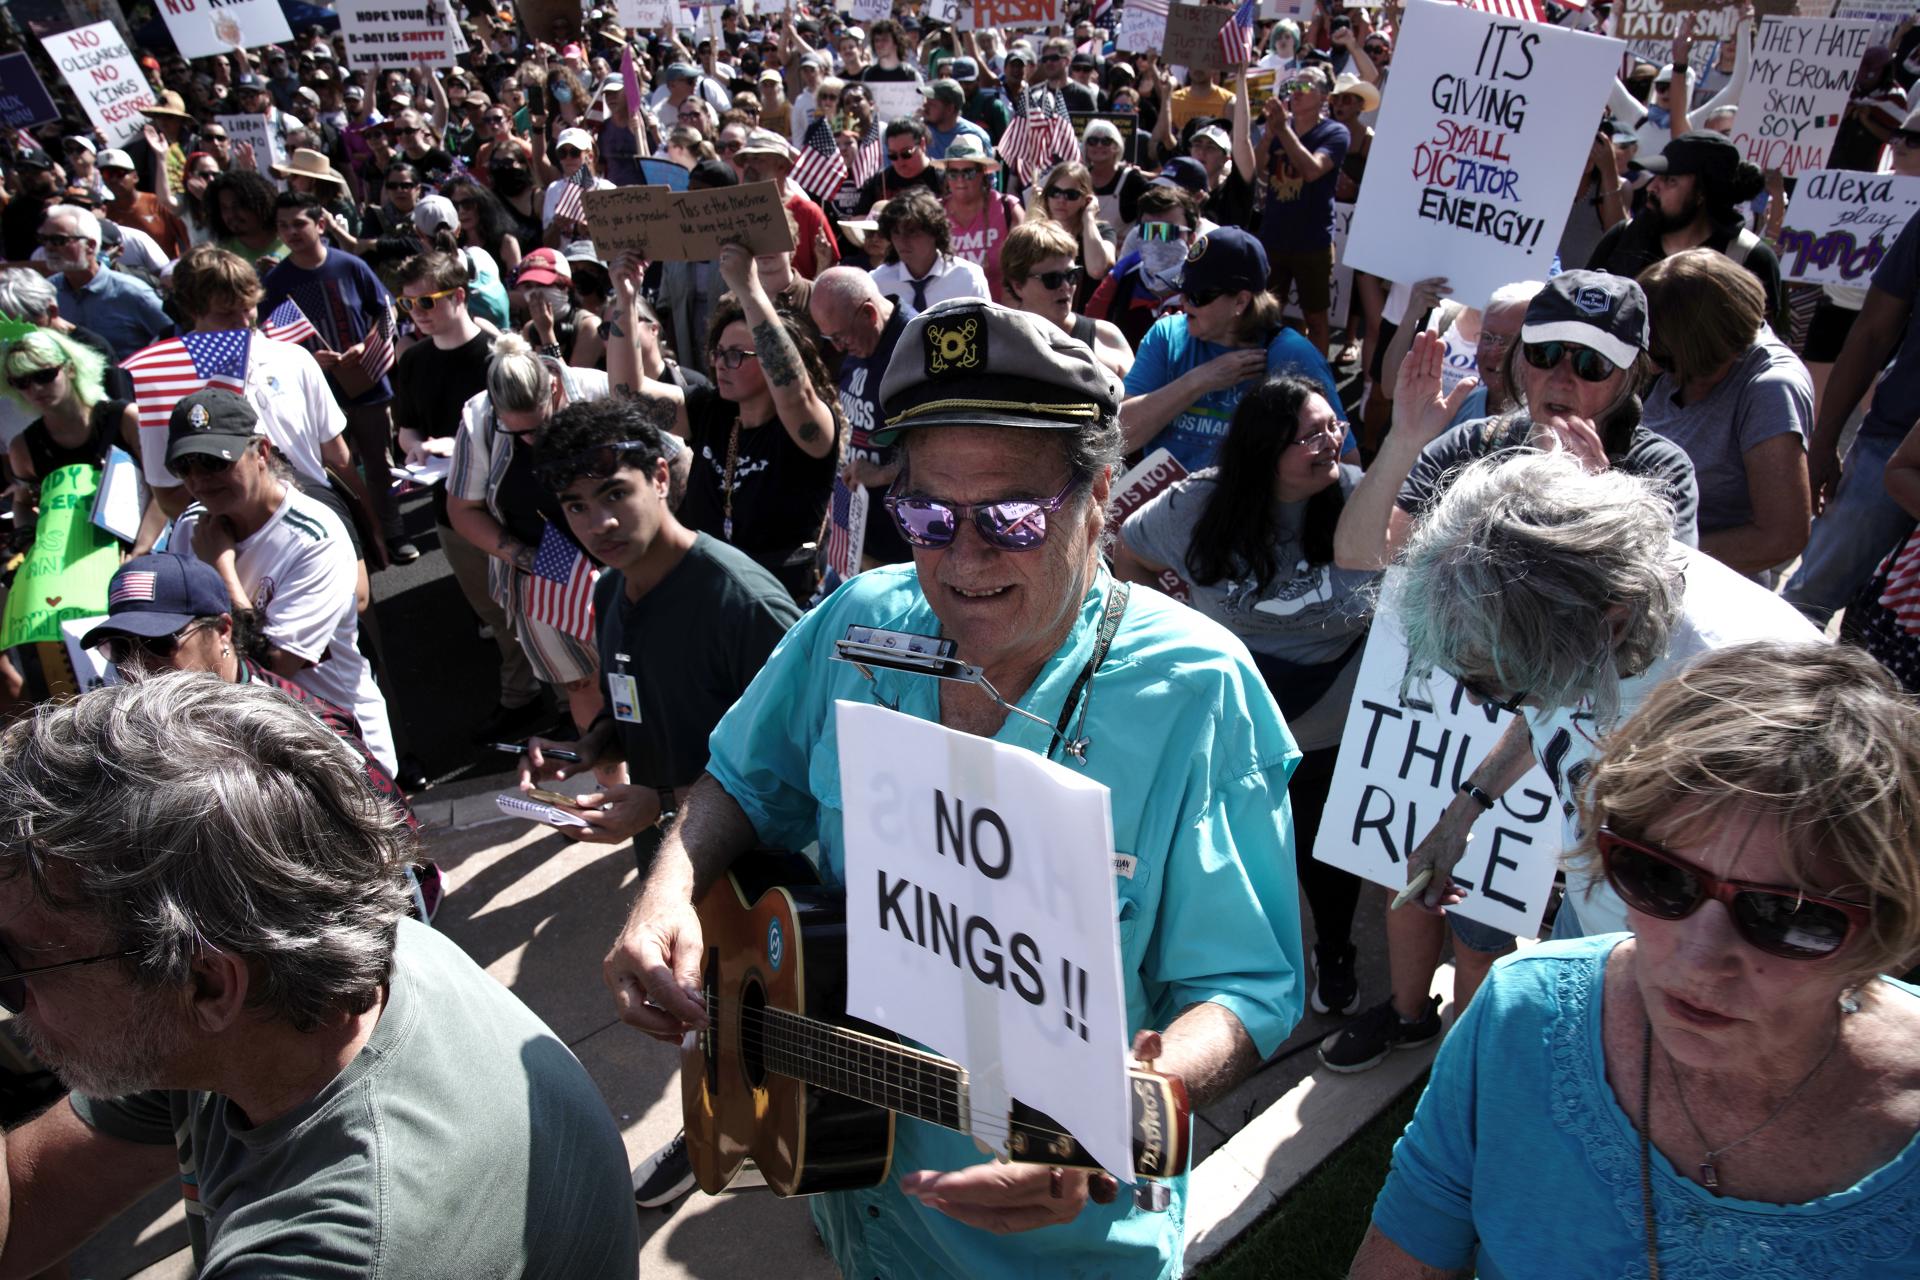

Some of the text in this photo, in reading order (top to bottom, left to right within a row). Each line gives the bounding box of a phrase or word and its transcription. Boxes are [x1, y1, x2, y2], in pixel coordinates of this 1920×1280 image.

[356, 9, 424, 22] HOPE YOUR
[67, 30, 100, 51] NO
[348, 33, 384, 43] B-DAY
[387, 32, 400, 42] IS
[1475, 22, 1541, 80] IT'S
[1762, 20, 1870, 58] THEY HATE
[61, 44, 129, 72] OLIGARCHS
[352, 53, 379, 63] LIKE
[381, 52, 409, 62] YOUR
[90, 65, 118, 85] NO
[1750, 58, 1856, 91] MY BROWN
[89, 79, 139, 106] KINGS
[1432, 74, 1528, 133] GIVING
[1764, 88, 1815, 116] SKIN
[1432, 119, 1510, 162] SMALL
[1760, 114, 1810, 141] SOY
[1411, 142, 1521, 202] DICTATOR
[1419, 187, 1545, 254] ENERGY!
[1829, 206, 1904, 240] play
[1118, 488, 1142, 508] IS
[1139, 456, 1176, 493] NOT
[934, 788, 1012, 880] NO
[878, 870, 1046, 1005] KINGS
